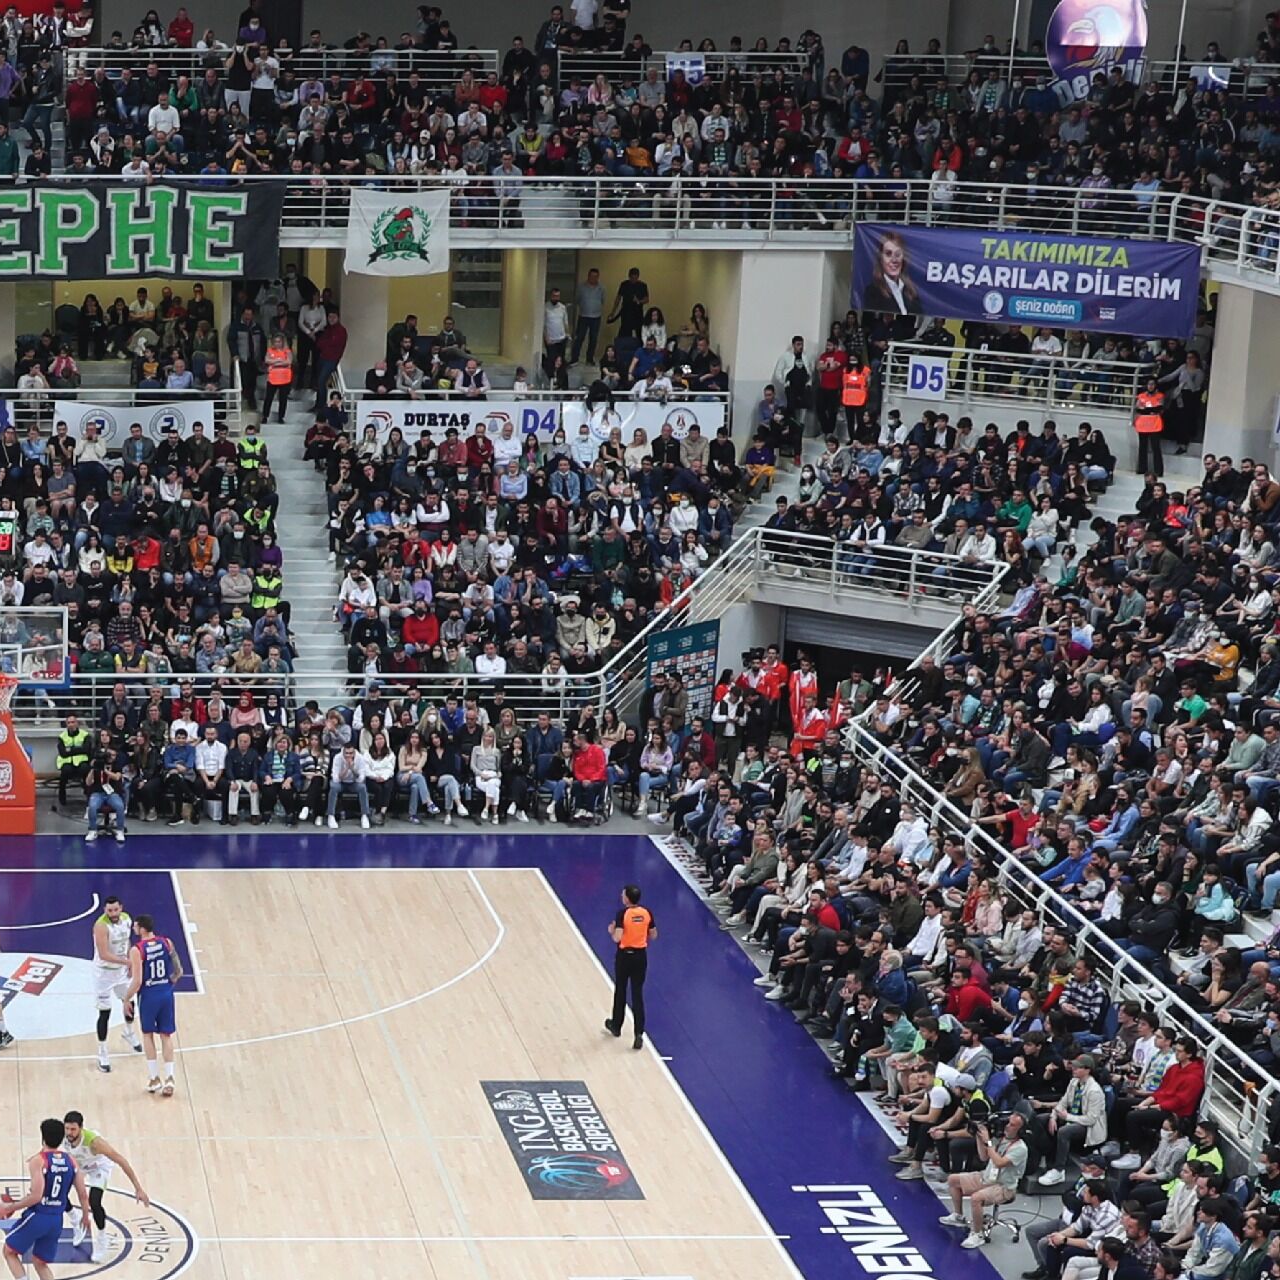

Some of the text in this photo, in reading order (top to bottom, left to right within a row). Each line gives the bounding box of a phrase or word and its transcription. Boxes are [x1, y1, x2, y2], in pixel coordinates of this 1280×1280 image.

[981, 238, 1129, 268] TAKIMIMIZA
[926, 261, 1181, 300] BAŞARILAR DİLERİM
[911, 363, 944, 392] D5
[404, 413, 470, 431] DURTAŞ
[522, 408, 556, 434] D4
[149, 959, 166, 979] 18
[509, 1113, 559, 1151] ING
[536, 1089, 587, 1151] BASKETBOL
[563, 1094, 618, 1151] SÜPER LİGİ
[51, 1175, 62, 1198] 6
[132, 1216, 171, 1264] DENİZLİ
